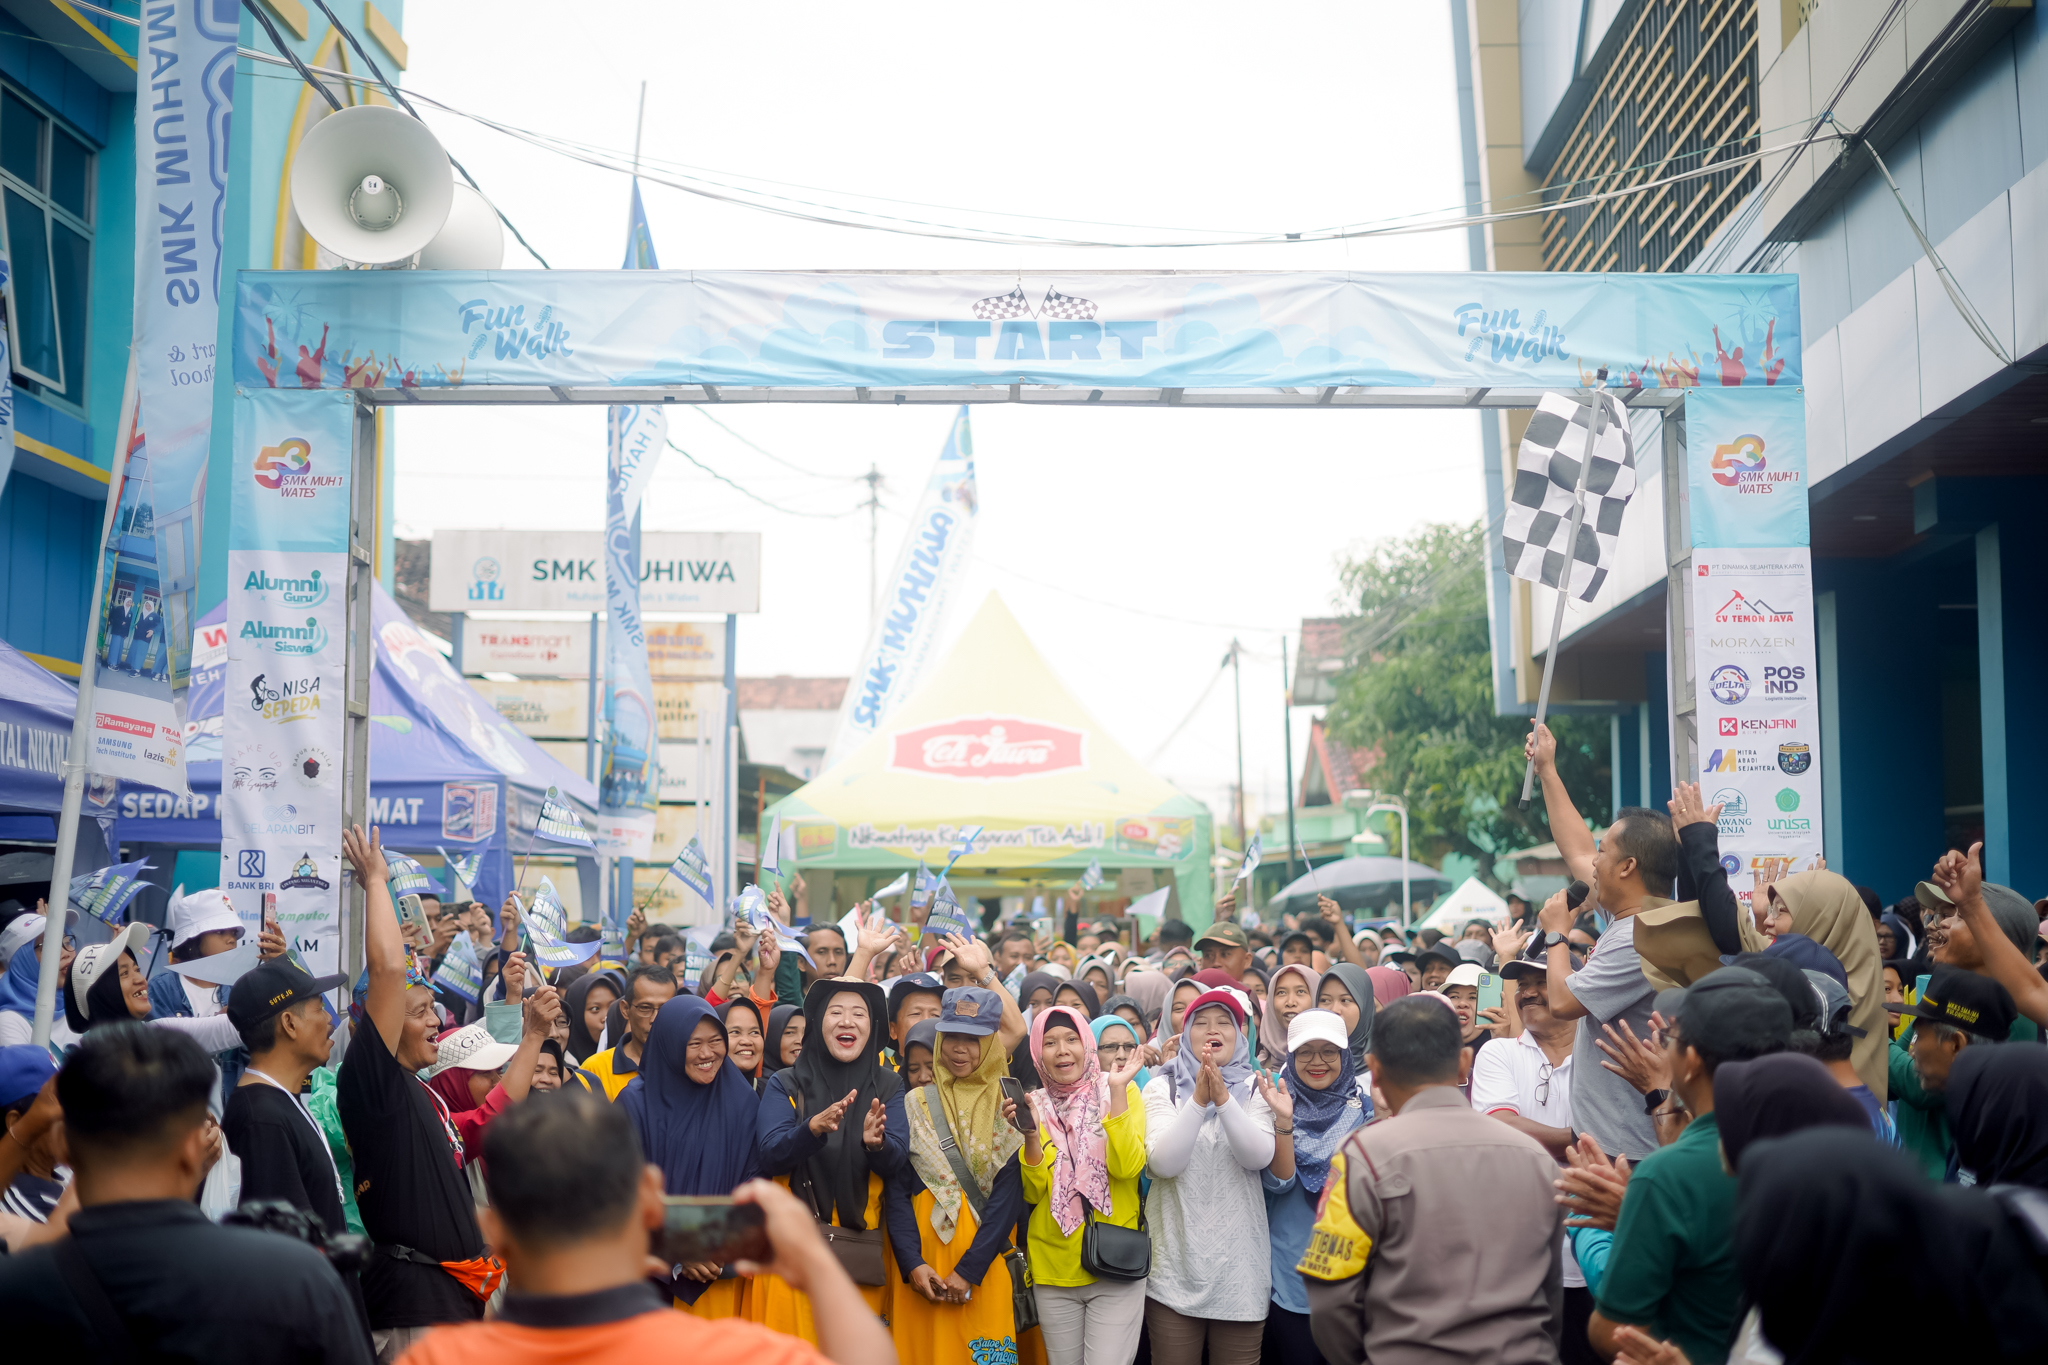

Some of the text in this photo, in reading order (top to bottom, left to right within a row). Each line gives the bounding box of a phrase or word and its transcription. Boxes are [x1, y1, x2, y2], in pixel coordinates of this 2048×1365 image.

[458, 299, 526, 334] Fun
[1453, 302, 1522, 337] Fun
[494, 321, 574, 361] Walk
[882, 320, 1158, 360] START
[1490, 325, 1571, 364] Walk
[281, 475, 343, 486] SMK MUH 1
[1739, 471, 1800, 482] SMK MUH 1
[281, 487, 316, 498] WATES
[1739, 483, 1774, 494] WATES
[532, 559, 597, 581] SMK
[243, 569, 322, 592] Alumni
[283, 592, 313, 603] Guru
[1715, 614, 1794, 623] CV TEMON JAYA
[239, 617, 317, 640] Alumni
[274, 640, 314, 653] Siswa
[646, 635, 704, 646] AMSUNG
[1710, 637, 1796, 648] MORAZEN
[1763, 666, 1806, 681] POS
[283, 676, 321, 698] NISA
[853, 656, 897, 729] SMK
[1715, 680, 1745, 690] DELTA
[262, 694, 321, 720] SEPEDA
[103, 717, 154, 734] Ramayana
[97, 736, 133, 750] SAMSUNG
[95, 747, 137, 761] Tech Institute
[143, 749, 177, 767] lazismu
[122, 793, 209, 819] SEDAP
[243, 824, 315, 835] DELAPANBIT
[1716, 818, 1752, 826] AWANG
[1767, 815, 1811, 830] unisa
[227, 881, 275, 890] BANK BRI
[276, 910, 330, 924] omputer
[269, 989, 293, 1006] SUTEJO
